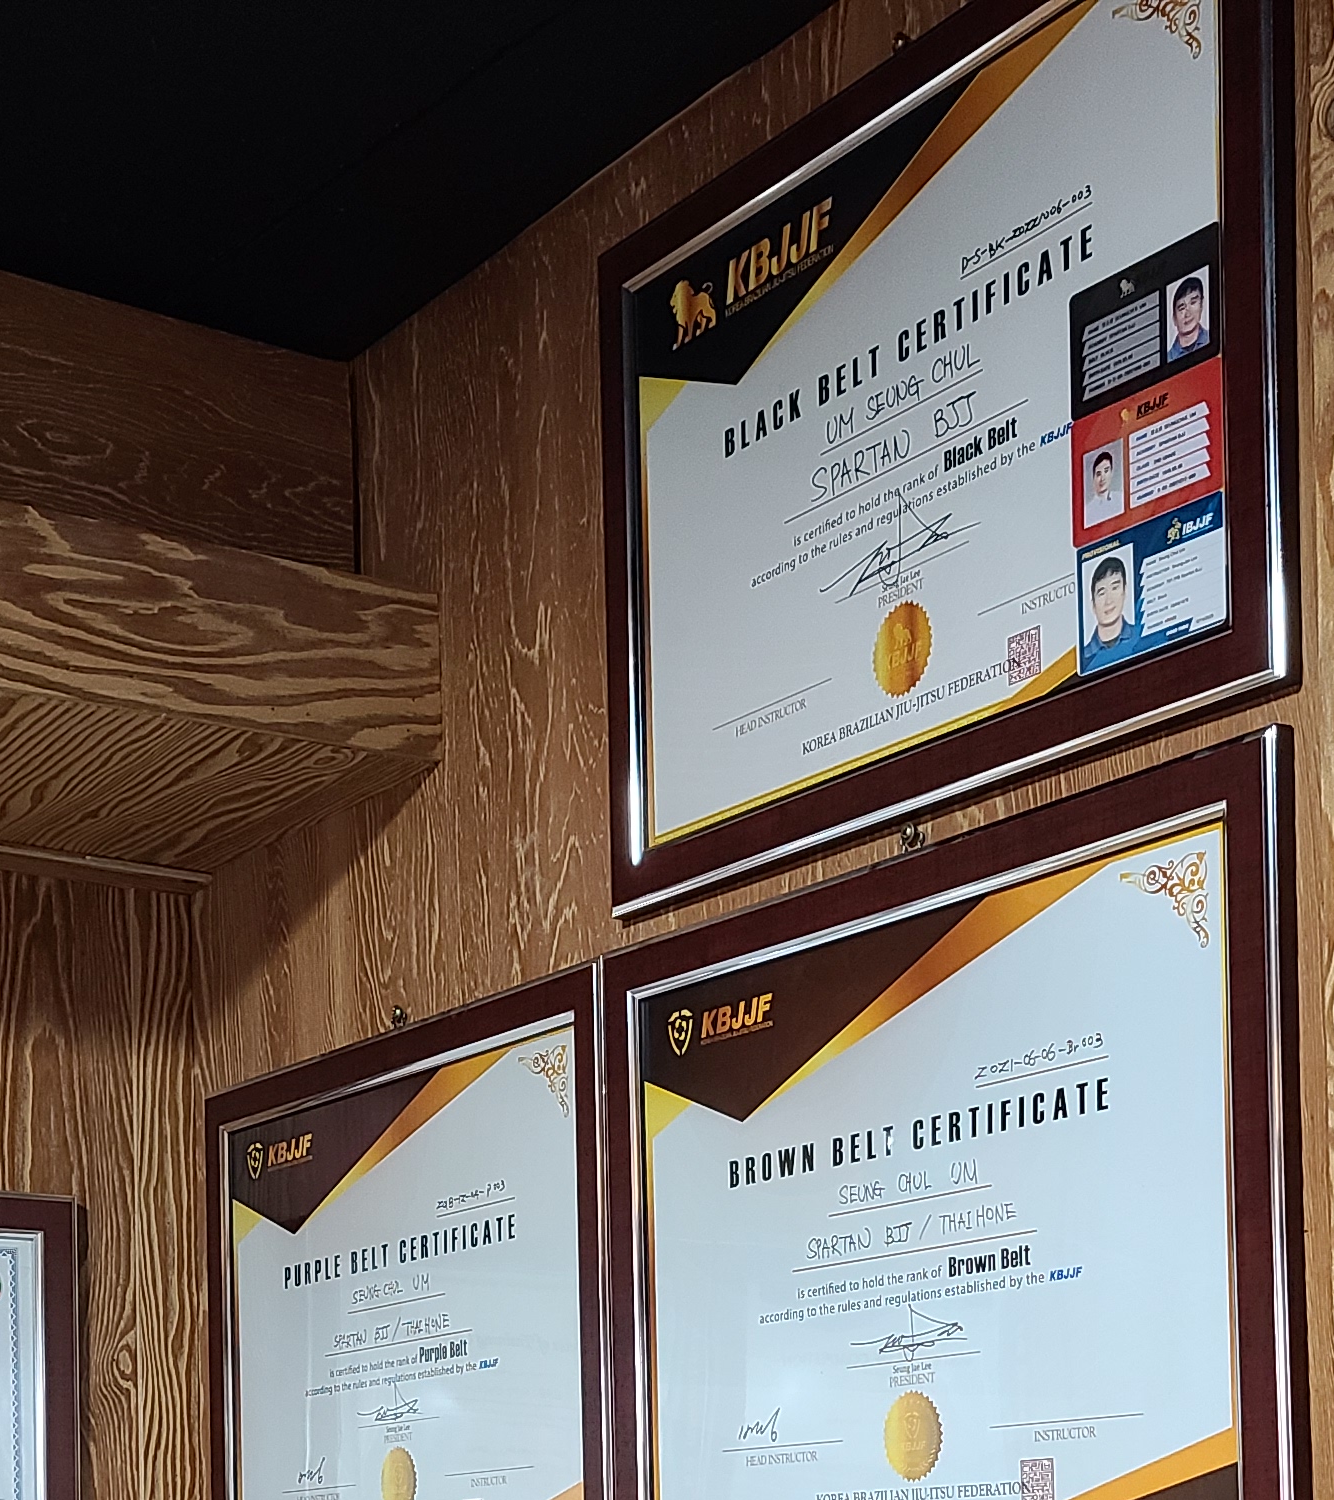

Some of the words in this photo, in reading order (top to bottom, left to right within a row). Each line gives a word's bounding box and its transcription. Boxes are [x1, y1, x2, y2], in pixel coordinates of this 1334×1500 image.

[724, 196, 834, 307] KBJJF
[724, 388, 801, 458] BLACK
[817, 344, 879, 407] BELT
[897, 223, 1093, 362] CERTIFICATE
[811, 429, 910, 502] SPARTAN
[1181, 511, 1215, 540] IBJJF
[801, 731, 837, 755] KOREA
[838, 707, 895, 740] BRAZILIAN
[896, 686, 945, 720] JIU-JITSU
[947, 655, 1021, 696] FEDERATION
[701, 993, 773, 1040] KBJJF
[267, 1133, 314, 1167] KBJJF
[728, 1142, 814, 1189] BROWN
[832, 1125, 894, 1167] BELT
[912, 1077, 1108, 1150] CERTIFICATE
[284, 1254, 340, 1289] PURPLE
[350, 1243, 388, 1274] BELT
[399, 1213, 515, 1264] CERTIFICATE
[797, 1289, 805, 1298] is
[807, 1280, 846, 1297] certified
[848, 1281, 859, 1291] to
[862, 1274, 884, 1288] hold
[887, 1273, 903, 1285] the
[906, 1267, 928, 1282] rank
[930, 1264, 942, 1278] of
[948, 1253, 996, 1278] Brown
[1000, 1244, 1031, 1269] Belt
[759, 1308, 804, 1324] according
[806, 1307, 817, 1317] to
[818, 1302, 835, 1315] the
[837, 1299, 861, 1313] rules
[863, 1294, 882, 1309] and
[884, 1288, 942, 1308] regulations
[944, 1275, 1006, 1297] established
[1008, 1274, 1023, 1290] by
[1025, 1271, 1045, 1285] the
[1048, 1265, 1083, 1282] KBJJF
[1033, 1425, 1096, 1442] INSTRUCTOR
